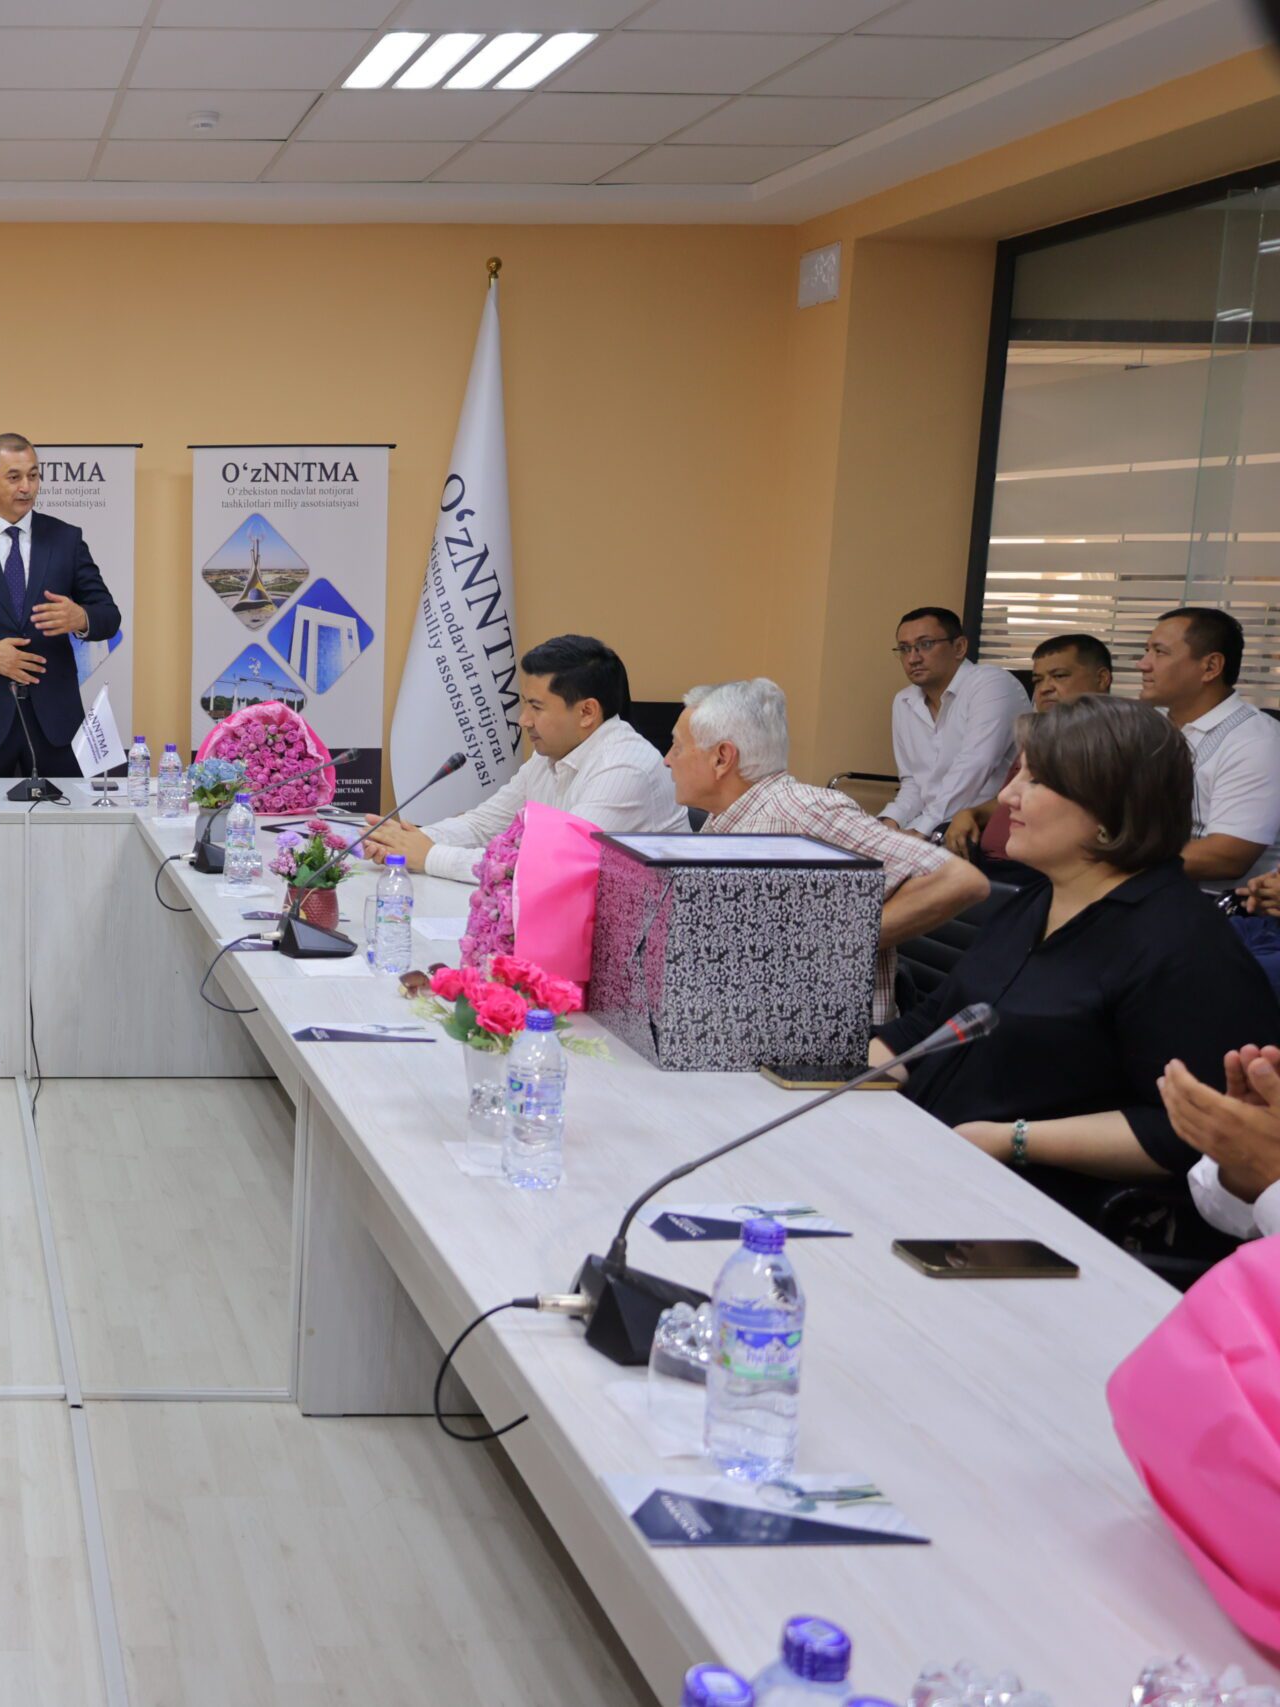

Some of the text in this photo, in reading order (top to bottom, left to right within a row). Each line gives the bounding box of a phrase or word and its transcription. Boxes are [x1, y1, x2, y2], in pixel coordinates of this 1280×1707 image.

[64, 486, 100, 497] notijorat
[280, 486, 316, 495] nodavlat
[318, 486, 354, 497] notijorat
[47, 499, 106, 510] assotsiatsiyasi
[221, 499, 359, 510] tashkilotlari milliy assotsiatsiyasi
[430, 538, 506, 765] kiston nodavlat notijorat
[423, 598, 496, 788] milliy assotsiatsiyasi
